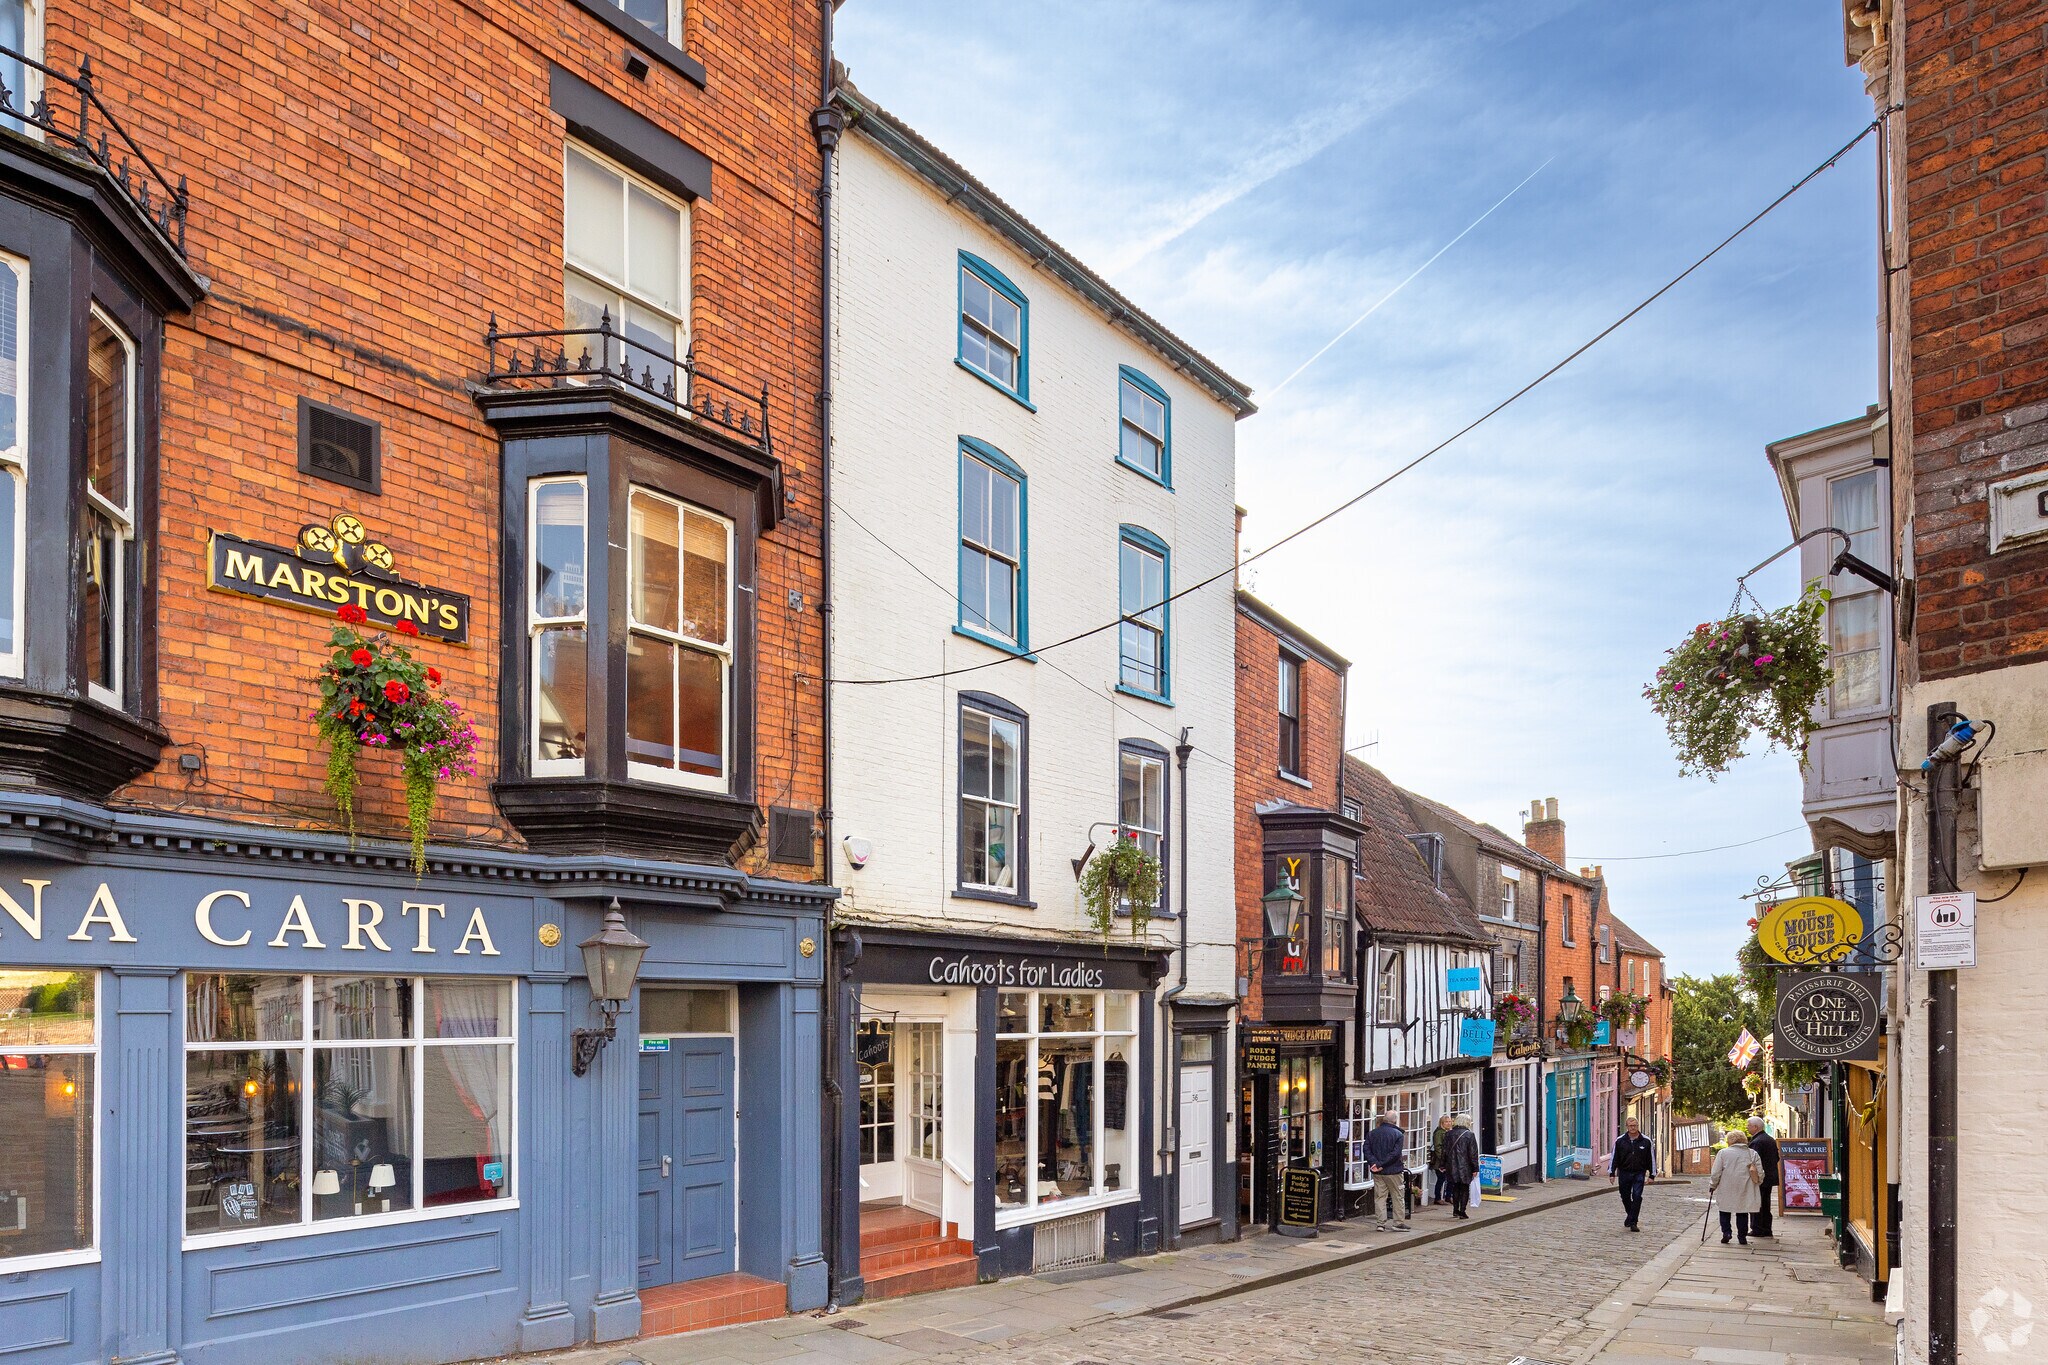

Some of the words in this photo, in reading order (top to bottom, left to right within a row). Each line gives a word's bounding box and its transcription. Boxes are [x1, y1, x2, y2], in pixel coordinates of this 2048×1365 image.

[223, 549, 459, 630] MARSTON'S
[195, 890, 501, 956] CARTA
[1802, 910, 1815, 918] THE
[1784, 914, 1835, 937] MOUSE
[1786, 929, 1835, 951] HOUSE
[929, 954, 1015, 985] Cahoots
[1019, 958, 1047, 985] for
[1051, 961, 1103, 988] Ladies
[1788, 980, 1843, 1002] PATISSERIE
[1847, 982, 1869, 1002] DELI
[1809, 994, 1847, 1009] ONE
[1795, 1006, 1860, 1022] CASTLE
[1306, 1029, 1333, 1041] PANTRY
[1783, 1024, 1843, 1054] HOMEWARES
[1845, 1025, 1872, 1049] GIFTS
[1806, 1021, 1848, 1037] HILL
[858, 1040, 889, 1060] Cahoots
[1509, 1041, 1541, 1057] Cahoots
